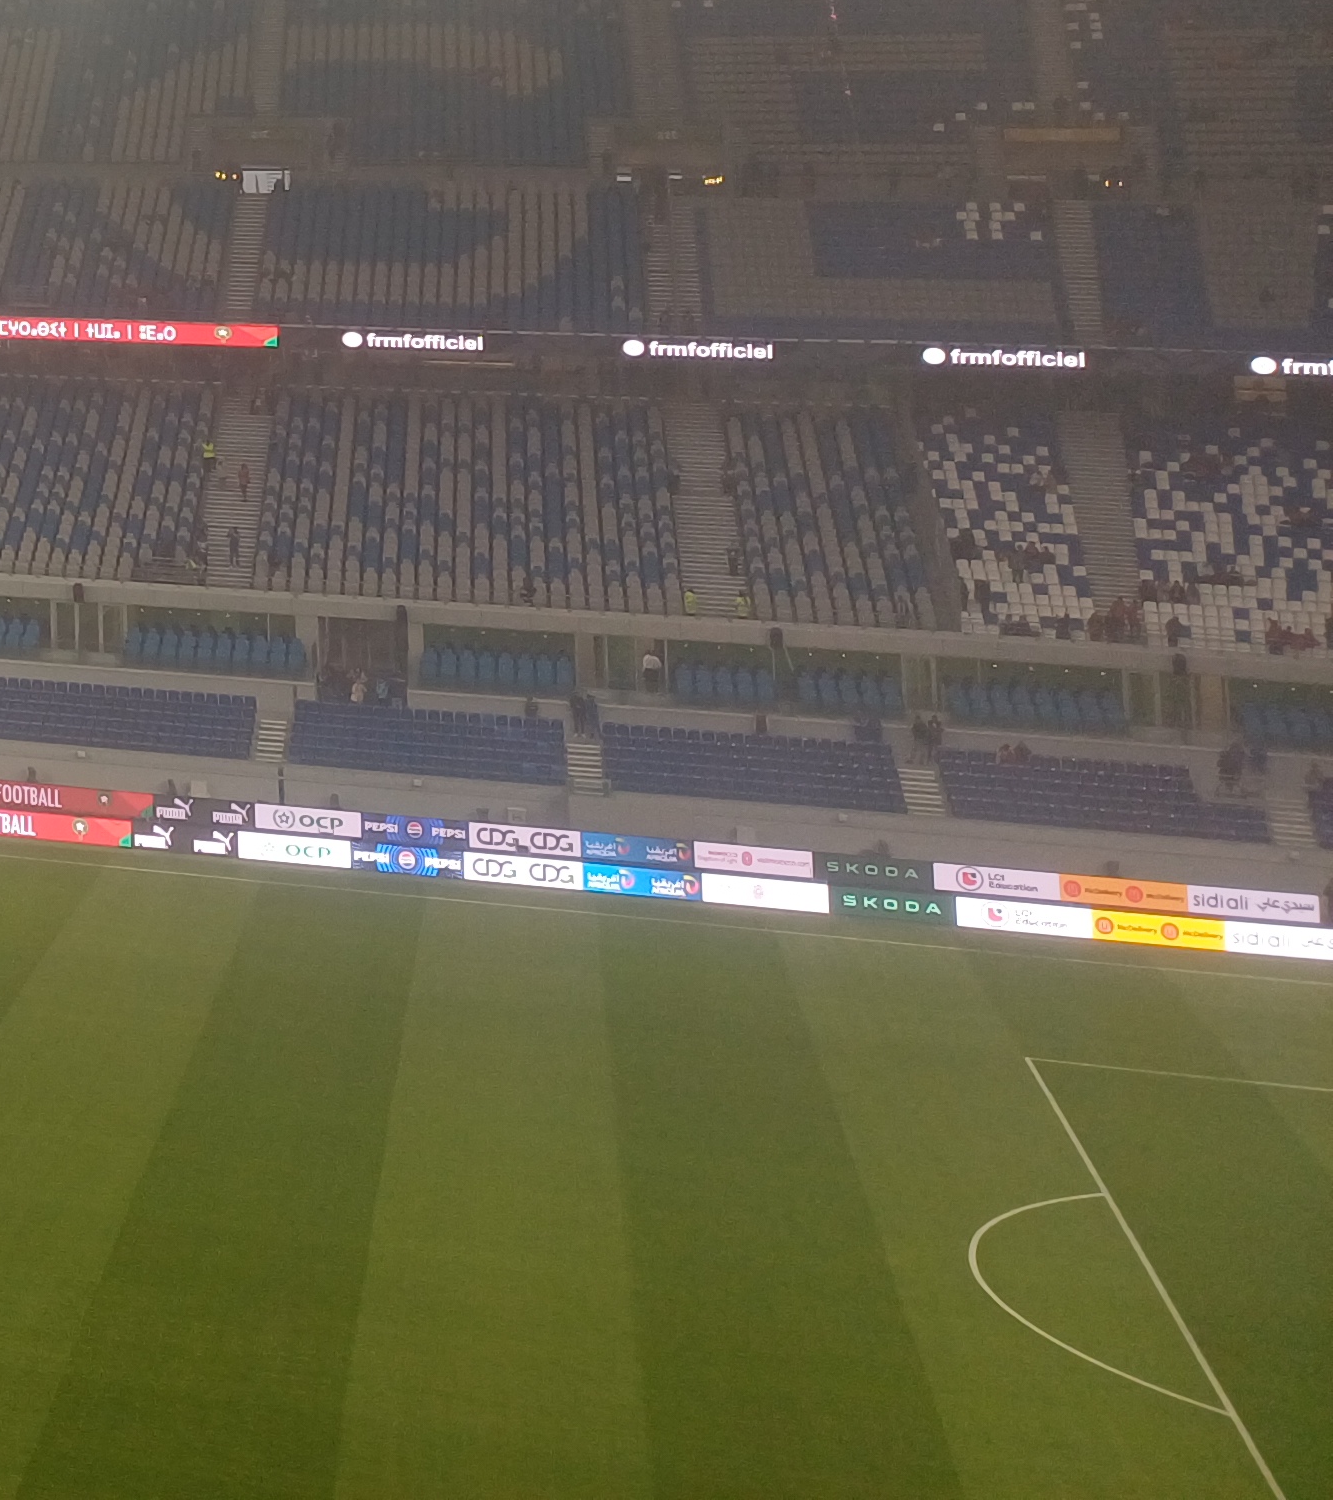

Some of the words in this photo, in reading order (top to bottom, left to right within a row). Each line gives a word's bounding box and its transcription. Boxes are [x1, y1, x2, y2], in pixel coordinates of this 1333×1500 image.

[367, 332, 484, 351] frmfofficiel
[649, 340, 774, 360] frmfofficiel
[950, 348, 1086, 368] frmfofficiel
[299, 814, 344, 829] OCP
[364, 821, 398, 834] PEPSI
[431, 827, 466, 840] PEPSI
[476, 827, 519, 848] CDG
[530, 831, 574, 853] CDG
[286, 844, 331, 859] OCP
[473, 857, 517, 879] CDG
[529, 863, 575, 884] CDG
[1193, 893, 1224, 909] sidi
[1226, 895, 1248, 910] ali
